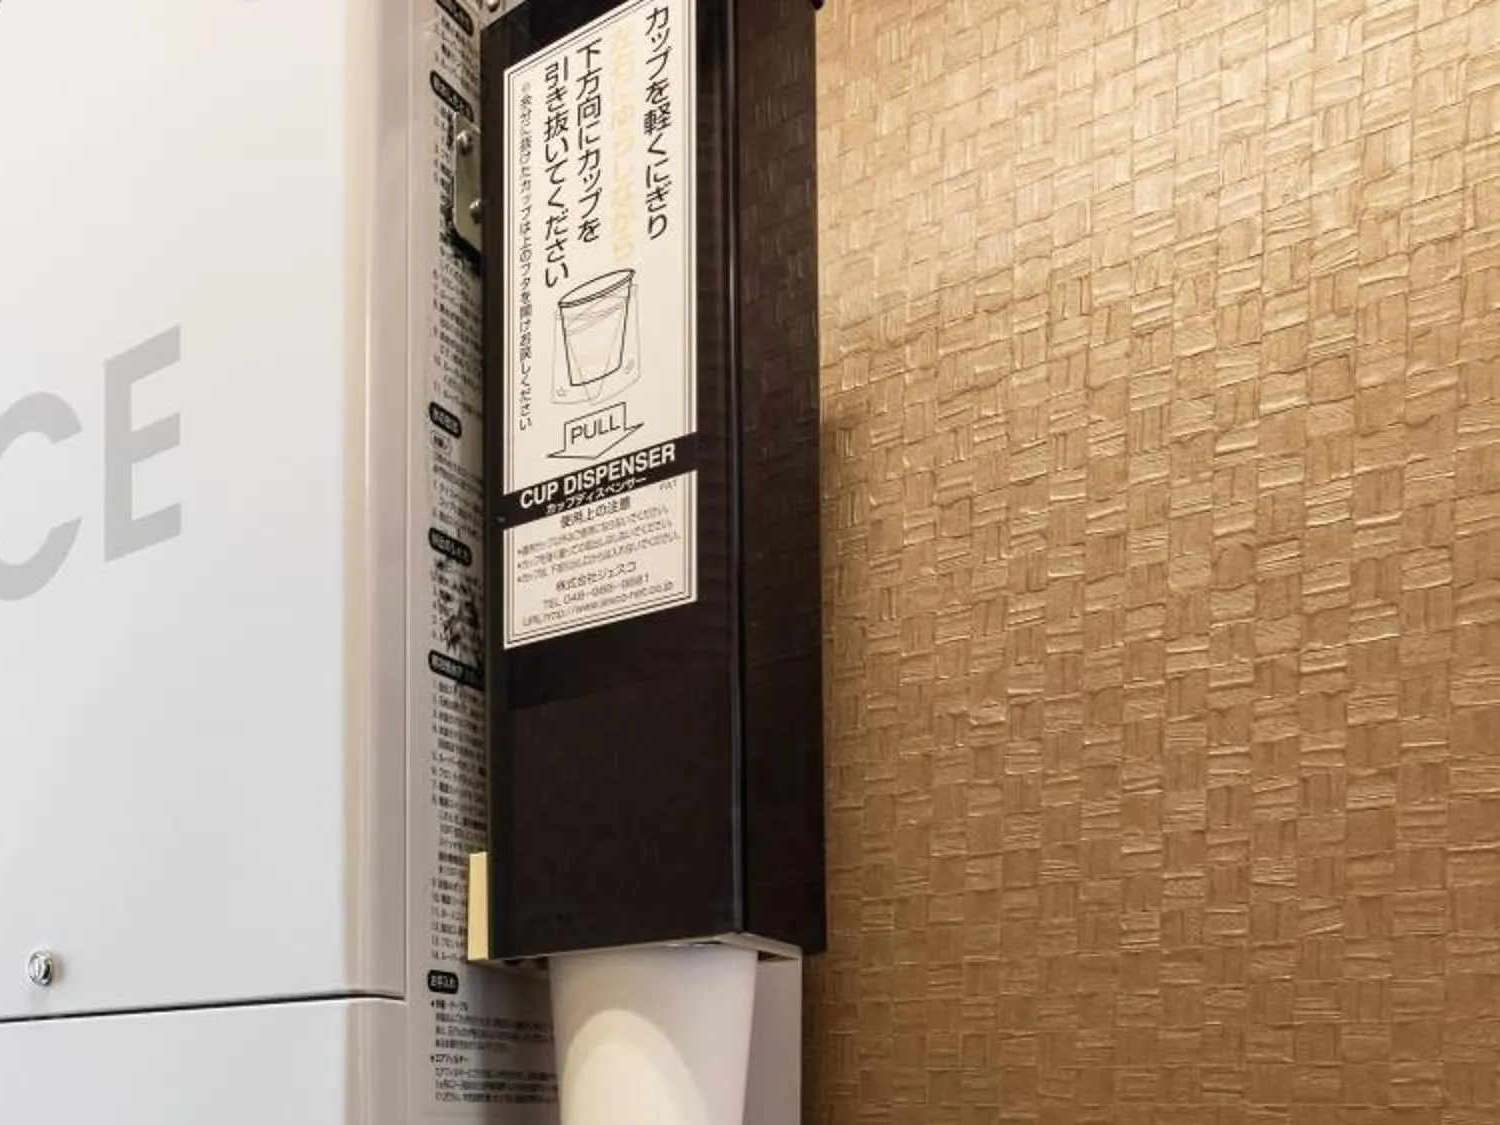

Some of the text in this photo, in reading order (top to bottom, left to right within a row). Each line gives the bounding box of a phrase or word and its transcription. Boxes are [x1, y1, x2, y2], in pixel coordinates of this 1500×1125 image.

[575, 37, 603, 243] 下方向にカップを
[643, 5, 672, 241] カップを軽くにぎり
[543, 55, 569, 289] 引き抜いてください
[571, 415, 621, 445] PULL
[519, 481, 559, 509] CUP
[563, 442, 677, 496] DISPENSER
[546, 476, 647, 516] カップディスペンサー
[560, 495, 631, 529] 使用上の注意
[555, 560, 637, 593] 株式会社ジェスコ
[543, 598, 561, 610] TEL
